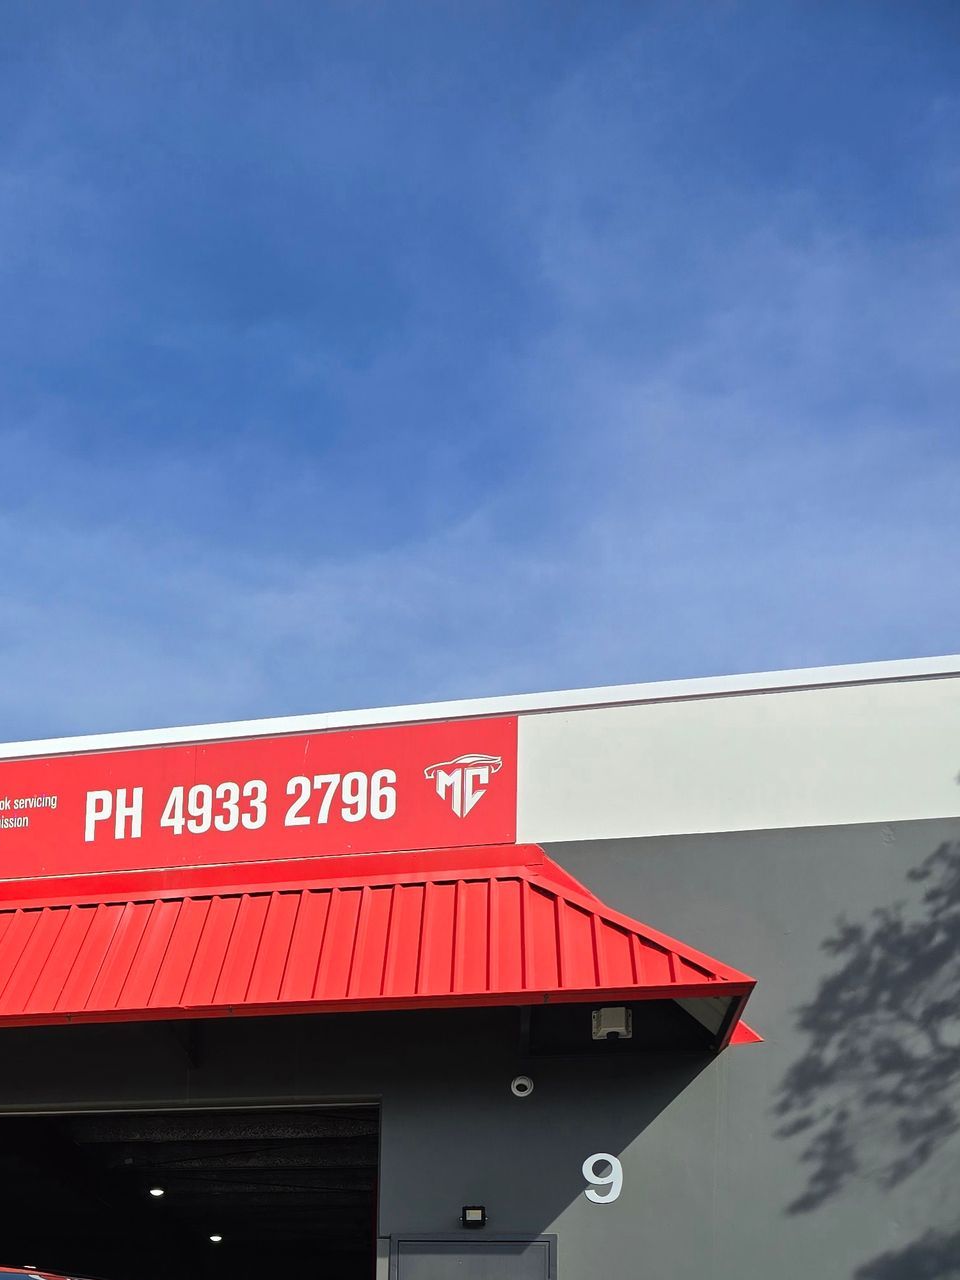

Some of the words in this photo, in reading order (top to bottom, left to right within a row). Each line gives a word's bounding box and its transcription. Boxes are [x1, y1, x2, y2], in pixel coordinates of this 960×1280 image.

[13, 794, 58, 811] servicing
[84, 786, 144, 842] PH
[159, 779, 268, 835] 4933
[284, 768, 398, 827] 2796
[435, 766, 491, 819] MC
[582, 1152, 624, 1205] 9
